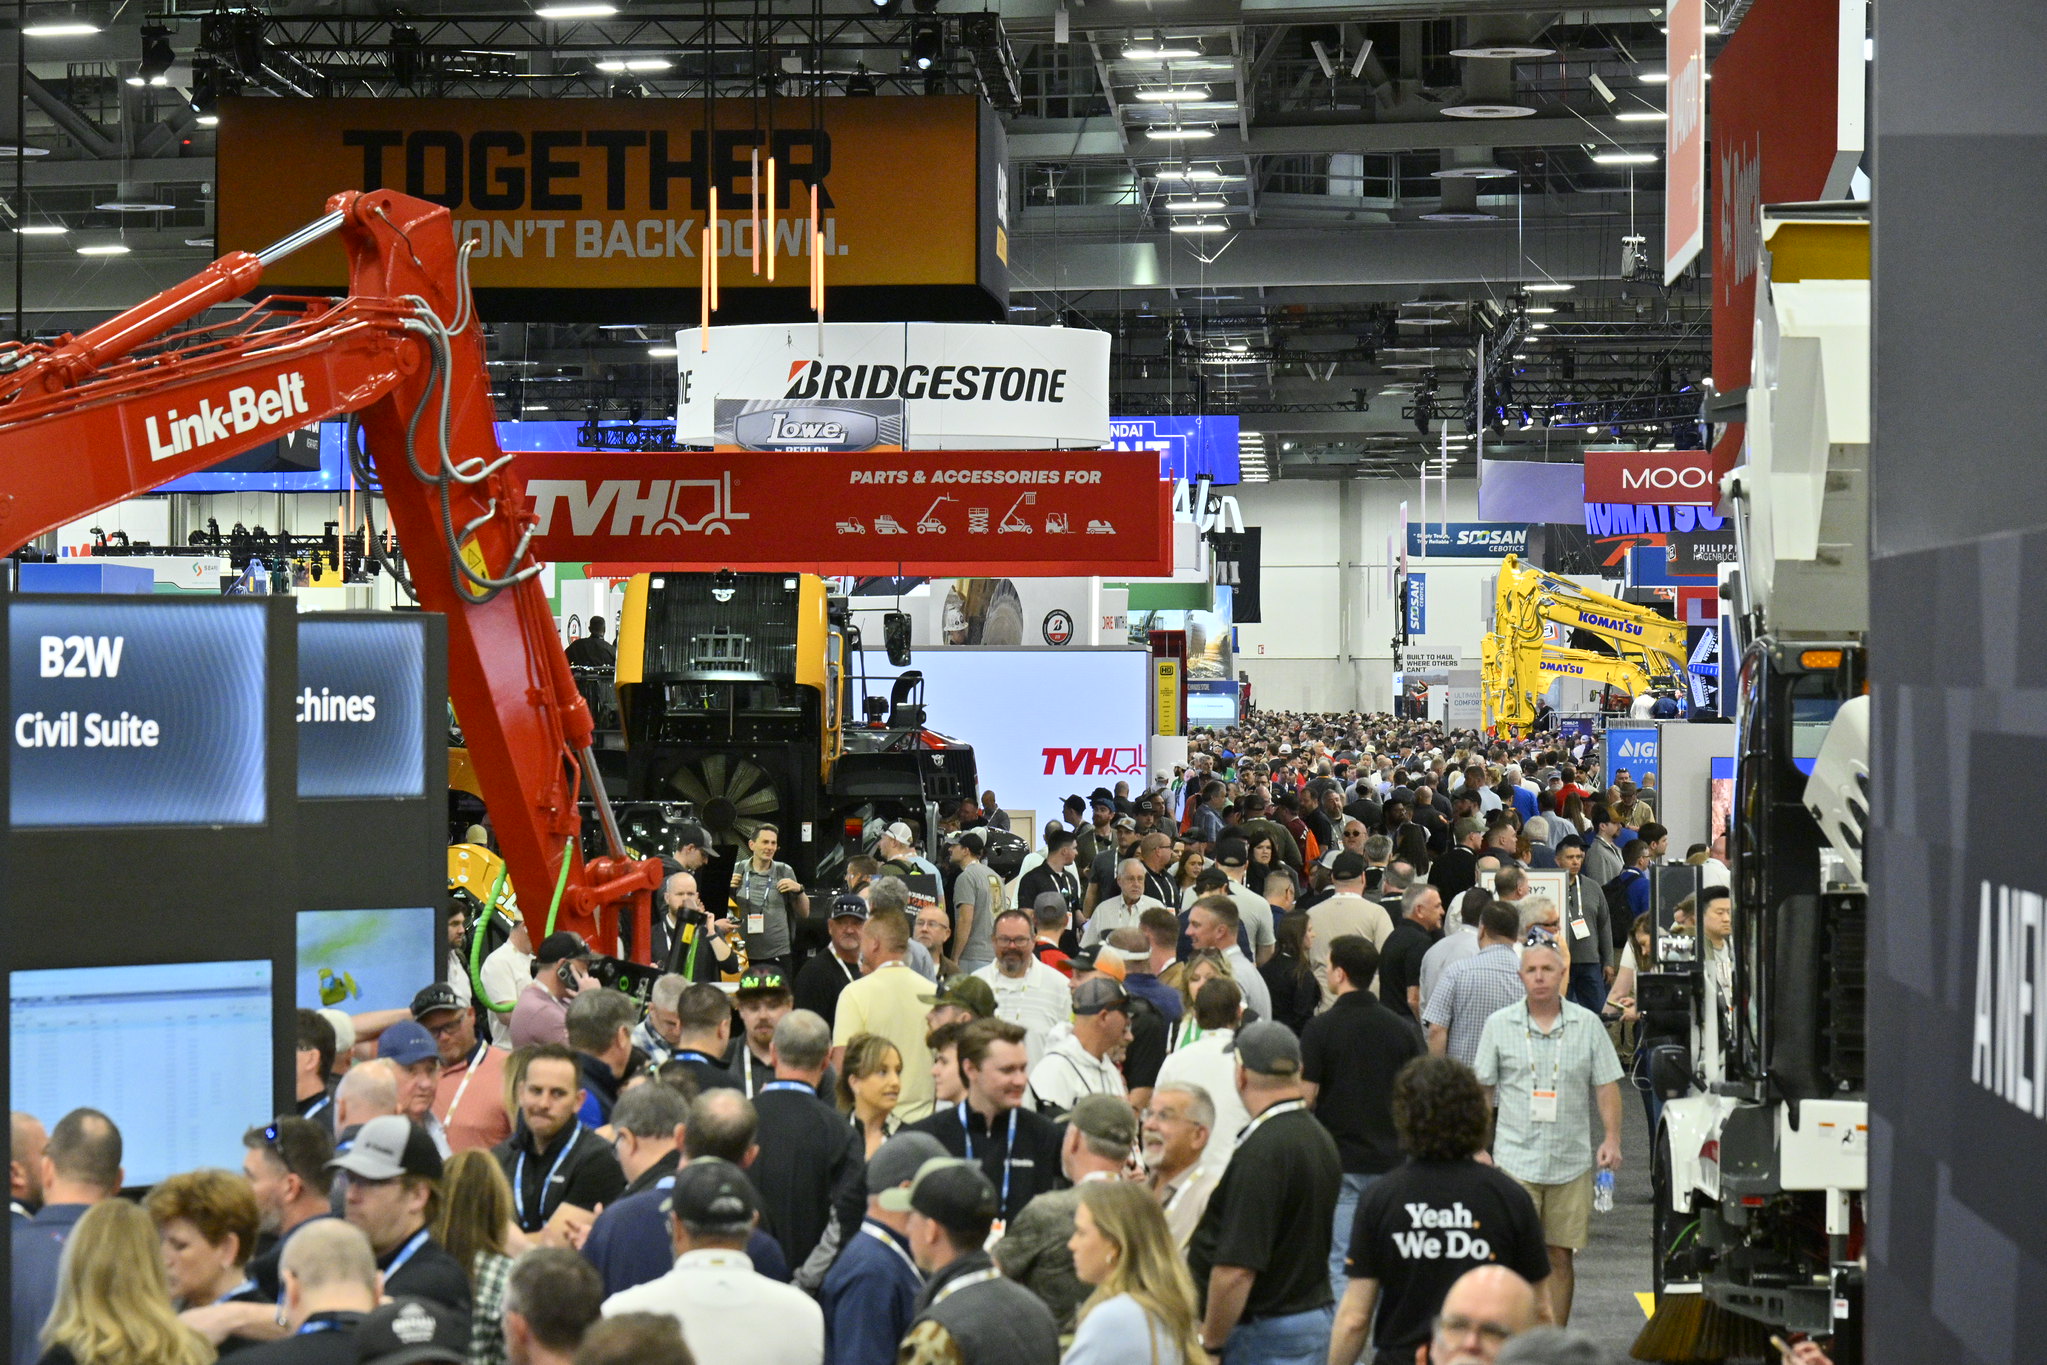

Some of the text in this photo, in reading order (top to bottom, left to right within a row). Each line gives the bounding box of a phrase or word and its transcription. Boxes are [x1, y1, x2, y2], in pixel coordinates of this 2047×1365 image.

[342, 129, 836, 211] TOGETHER
[453, 218, 566, 259] ON'T
[575, 218, 697, 259] BACK
[784, 359, 1067, 403] BRIDGESTONE
[145, 371, 309, 463] Link-Belt
[766, 411, 850, 445] Lowe
[849, 470, 1102, 485] PARTS & ACCESSORIES FOR
[1622, 466, 1713, 489] MOO
[525, 479, 672, 536] TVH
[1457, 530, 1527, 545] SOOSAN
[1579, 610, 1644, 637] KOMATSU
[40, 636, 124, 678] B2W
[14, 711, 160, 748] Civil Suite
[1042, 747, 1113, 775] TVH
[1404, 1201, 1481, 1229] Yeah.
[1391, 1230, 1497, 1261] We Do.
